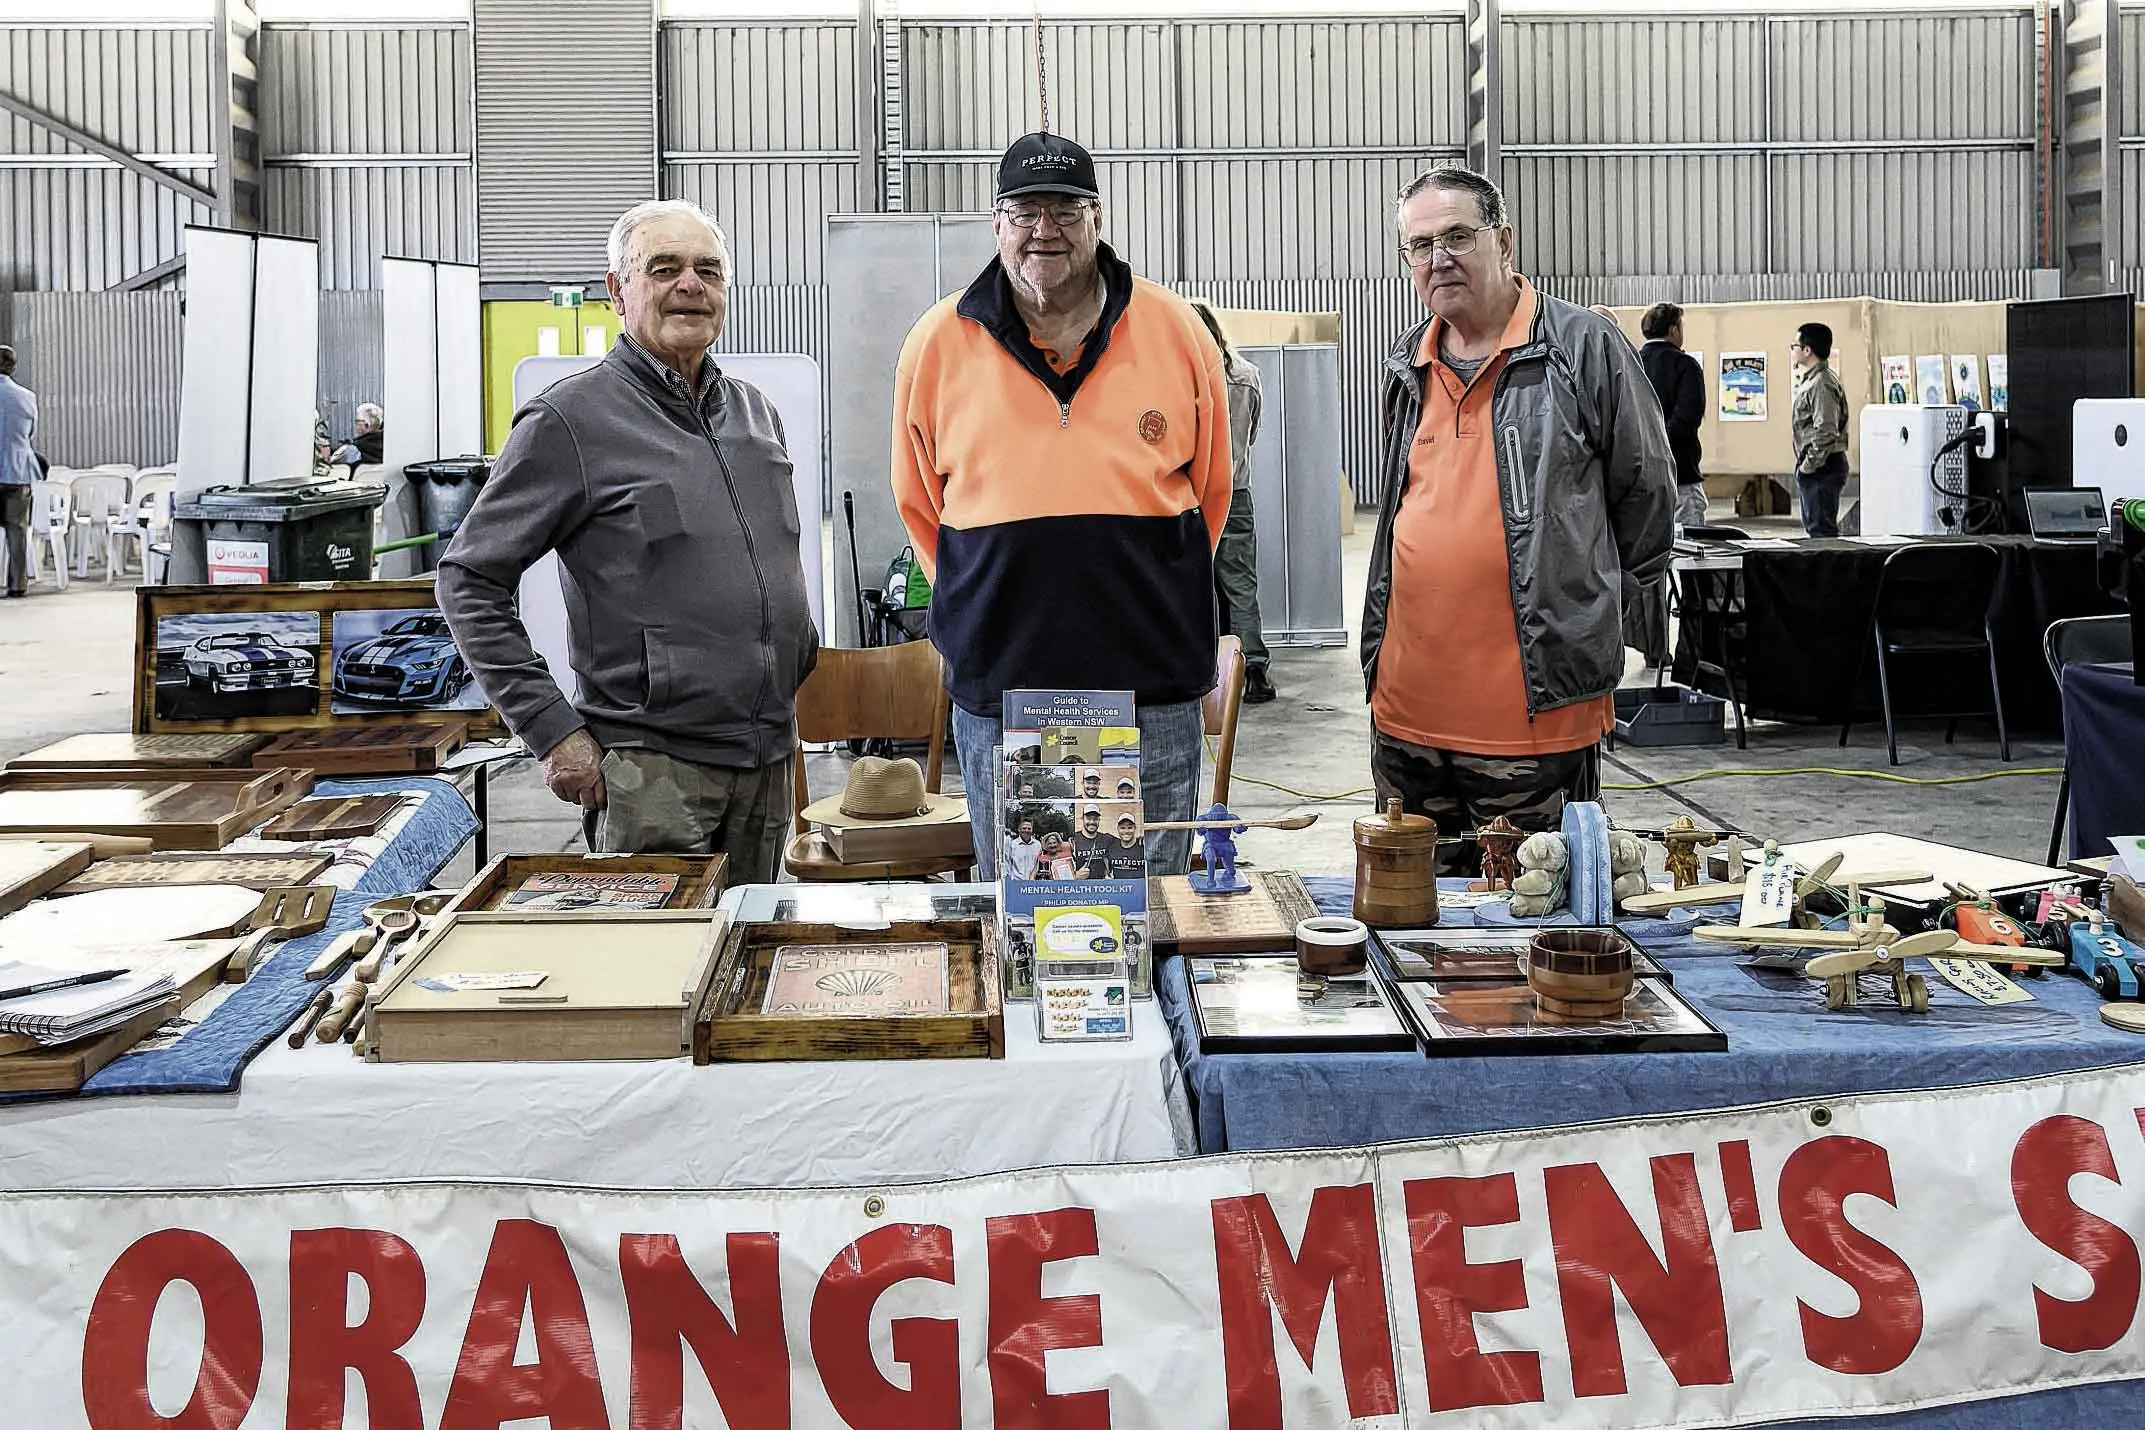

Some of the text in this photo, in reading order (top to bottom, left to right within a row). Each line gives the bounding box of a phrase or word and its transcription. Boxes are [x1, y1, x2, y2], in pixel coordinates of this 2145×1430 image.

[1021, 154, 1077, 168] PERFECT
[1053, 696, 1089, 705] Guide to
[1023, 706, 1119, 717] Mental Health Services
[1037, 718, 1106, 727] in Western NSW
[1020, 884, 1134, 894] MENTAL HEALTH TOOL KIT
[2096, 937, 2125, 958] 3
[784, 957, 938, 972] SHELL
[82, 1113, 2145, 1430] ORANGE MEN'S S
